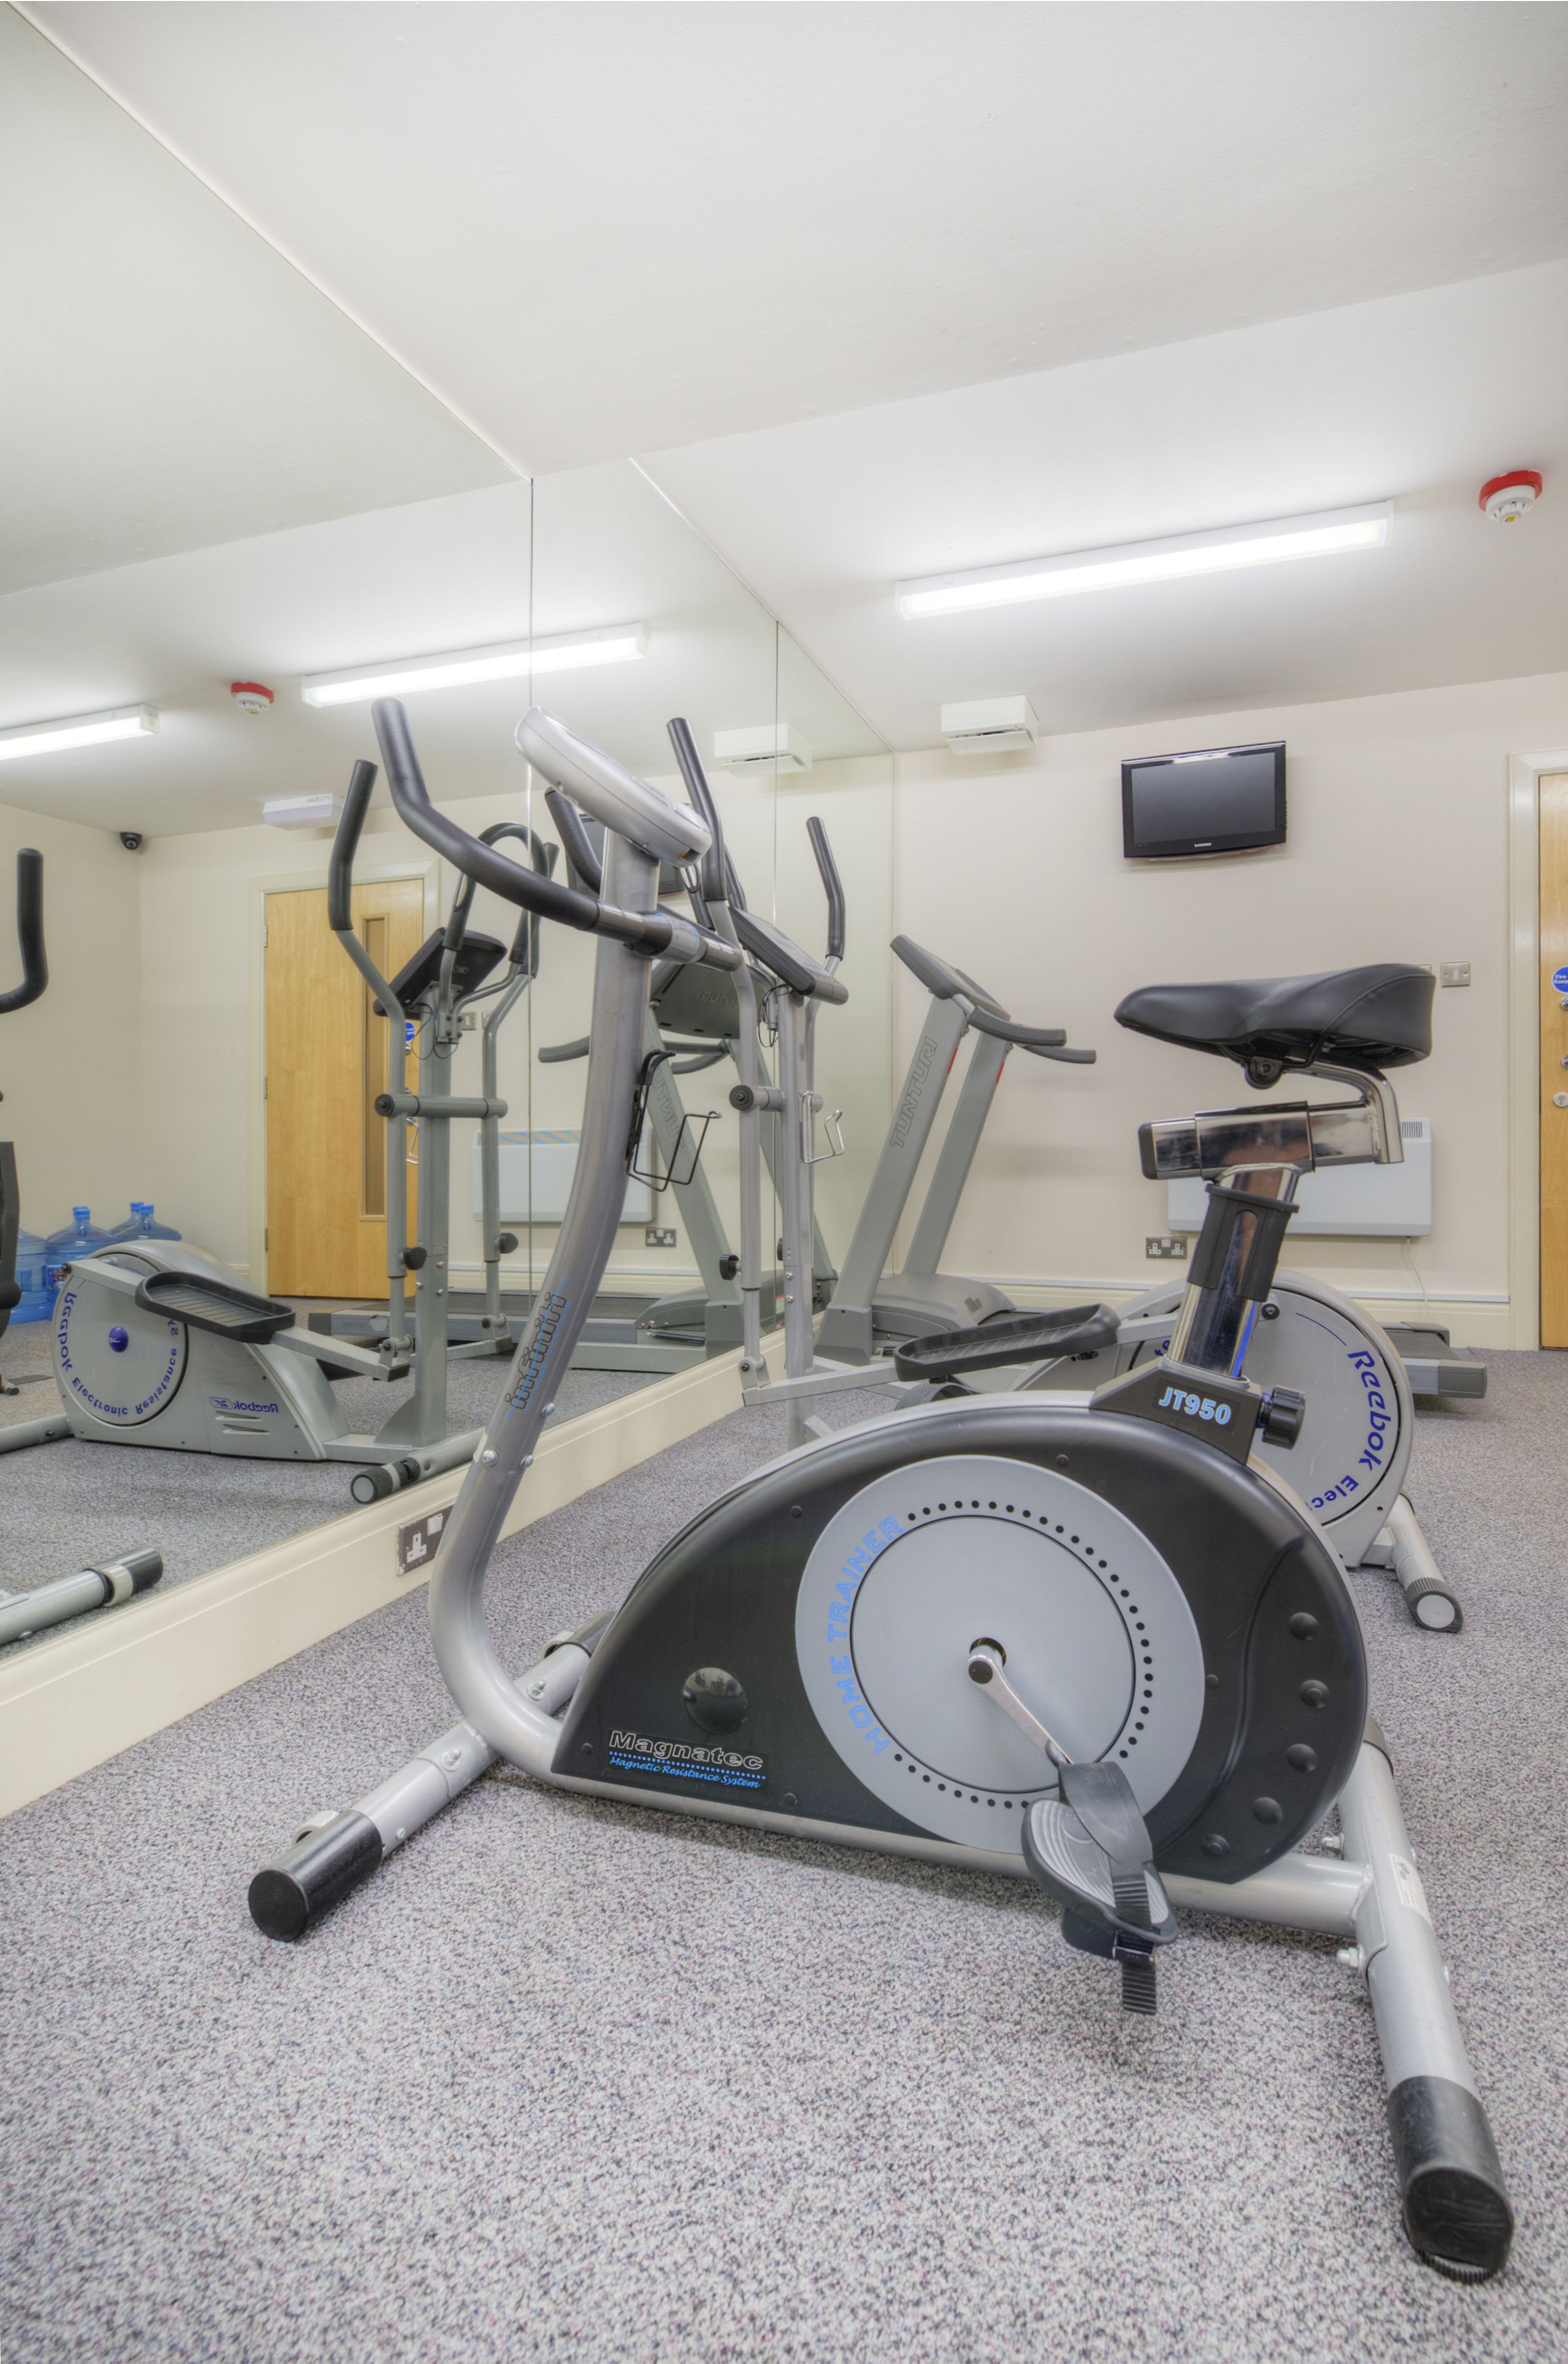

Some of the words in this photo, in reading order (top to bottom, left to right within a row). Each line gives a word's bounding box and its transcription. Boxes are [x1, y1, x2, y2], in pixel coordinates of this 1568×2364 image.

[890, 1036, 938, 1148] TUNTURI
[505, 1292, 566, 1409] infiniti
[1159, 1387, 1231, 1425] JT950
[1347, 1351, 1391, 1471] Reebok
[827, 1516, 904, 1643] TRAINER
[609, 1731, 763, 1770] Magnatec
[829, 1654, 891, 1754] HOME
[609, 1756, 661, 1773] Magnetic
[662, 1765, 720, 1782] Resistance
[721, 1774, 760, 1788] System
